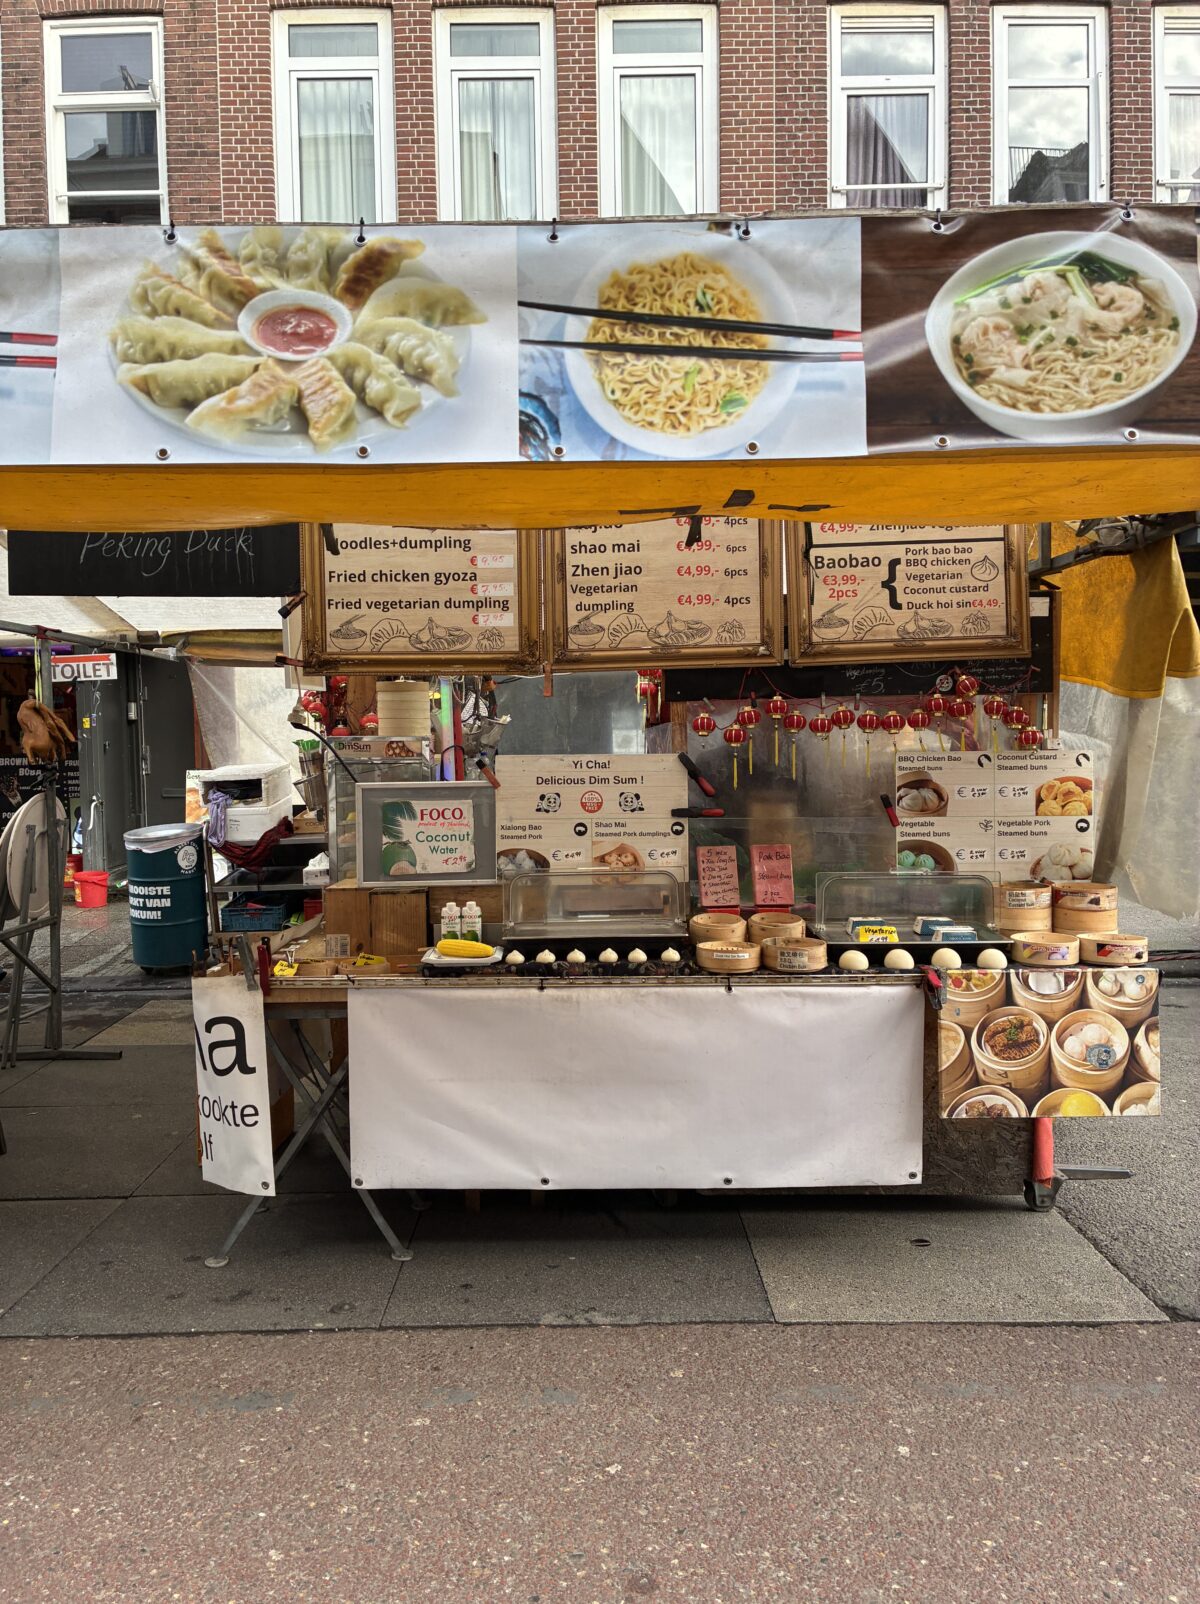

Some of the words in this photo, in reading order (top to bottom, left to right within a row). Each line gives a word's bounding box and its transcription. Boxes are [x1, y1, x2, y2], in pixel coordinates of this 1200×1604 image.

[724, 516, 748, 526] 4pcs
[820, 523, 863, 534] €4,99,-
[335, 536, 472, 552] oodles+dumpling
[570, 541, 607, 554] shao
[611, 540, 641, 553] mai
[726, 544, 747, 553] 6pcs
[80, 531, 171, 576] Peking
[184, 529, 255, 556] Duck
[905, 547, 929, 556] Pork
[931, 546, 951, 555] bao
[953, 545, 973, 554] bao
[813, 554, 882, 570] Baobao
[905, 558, 928, 568] BBQ
[930, 557, 971, 567] chicken
[328, 571, 367, 582] Fried
[371, 569, 430, 582] chicken
[433, 571, 477, 585] gyoza
[571, 565, 609, 577] Zhen
[612, 563, 643, 579] jiao
[676, 565, 720, 577] €4,99,-
[724, 567, 748, 577] 6pcs
[905, 571, 963, 582] Vegetarian
[822, 574, 865, 587] €3,99,-
[570, 583, 638, 596] Vegetarian
[828, 587, 858, 599] 2pcs
[903, 586, 947, 595] Coconut
[949, 583, 989, 594] custard
[327, 599, 362, 609] Fried
[366, 598, 440, 612] vegetarian
[444, 597, 510, 612] dumpling
[677, 594, 720, 606] €4,99,-
[724, 594, 751, 605] 4pcs
[906, 601, 934, 610] Duck
[936, 600, 953, 609] hoi
[956, 599, 971, 608] sin
[575, 600, 635, 613] dumpling
[51, 662, 113, 679] TOILET
[338, 742, 371, 751] DimSum
[0, 758, 28, 766] BROWN
[572, 760, 583, 769] Yi
[586, 760, 611, 769] Cha!
[898, 755, 915, 763] BBQ
[536, 776, 586, 785] Delicious
[588, 776, 610, 785] Dim
[613, 775, 637, 784] Sum
[420, 807, 463, 820] FOCO
[899, 820, 935, 829] Vegetable
[415, 831, 471, 843] Coconut
[638, 830, 671, 838] dumplings
[429, 845, 458, 854] Water
[145, 898, 171, 908] VAN
[130, 908, 162, 919] OKUM!
[199, 1096, 259, 1128] ookte
[201, 1131, 213, 1162] lf
